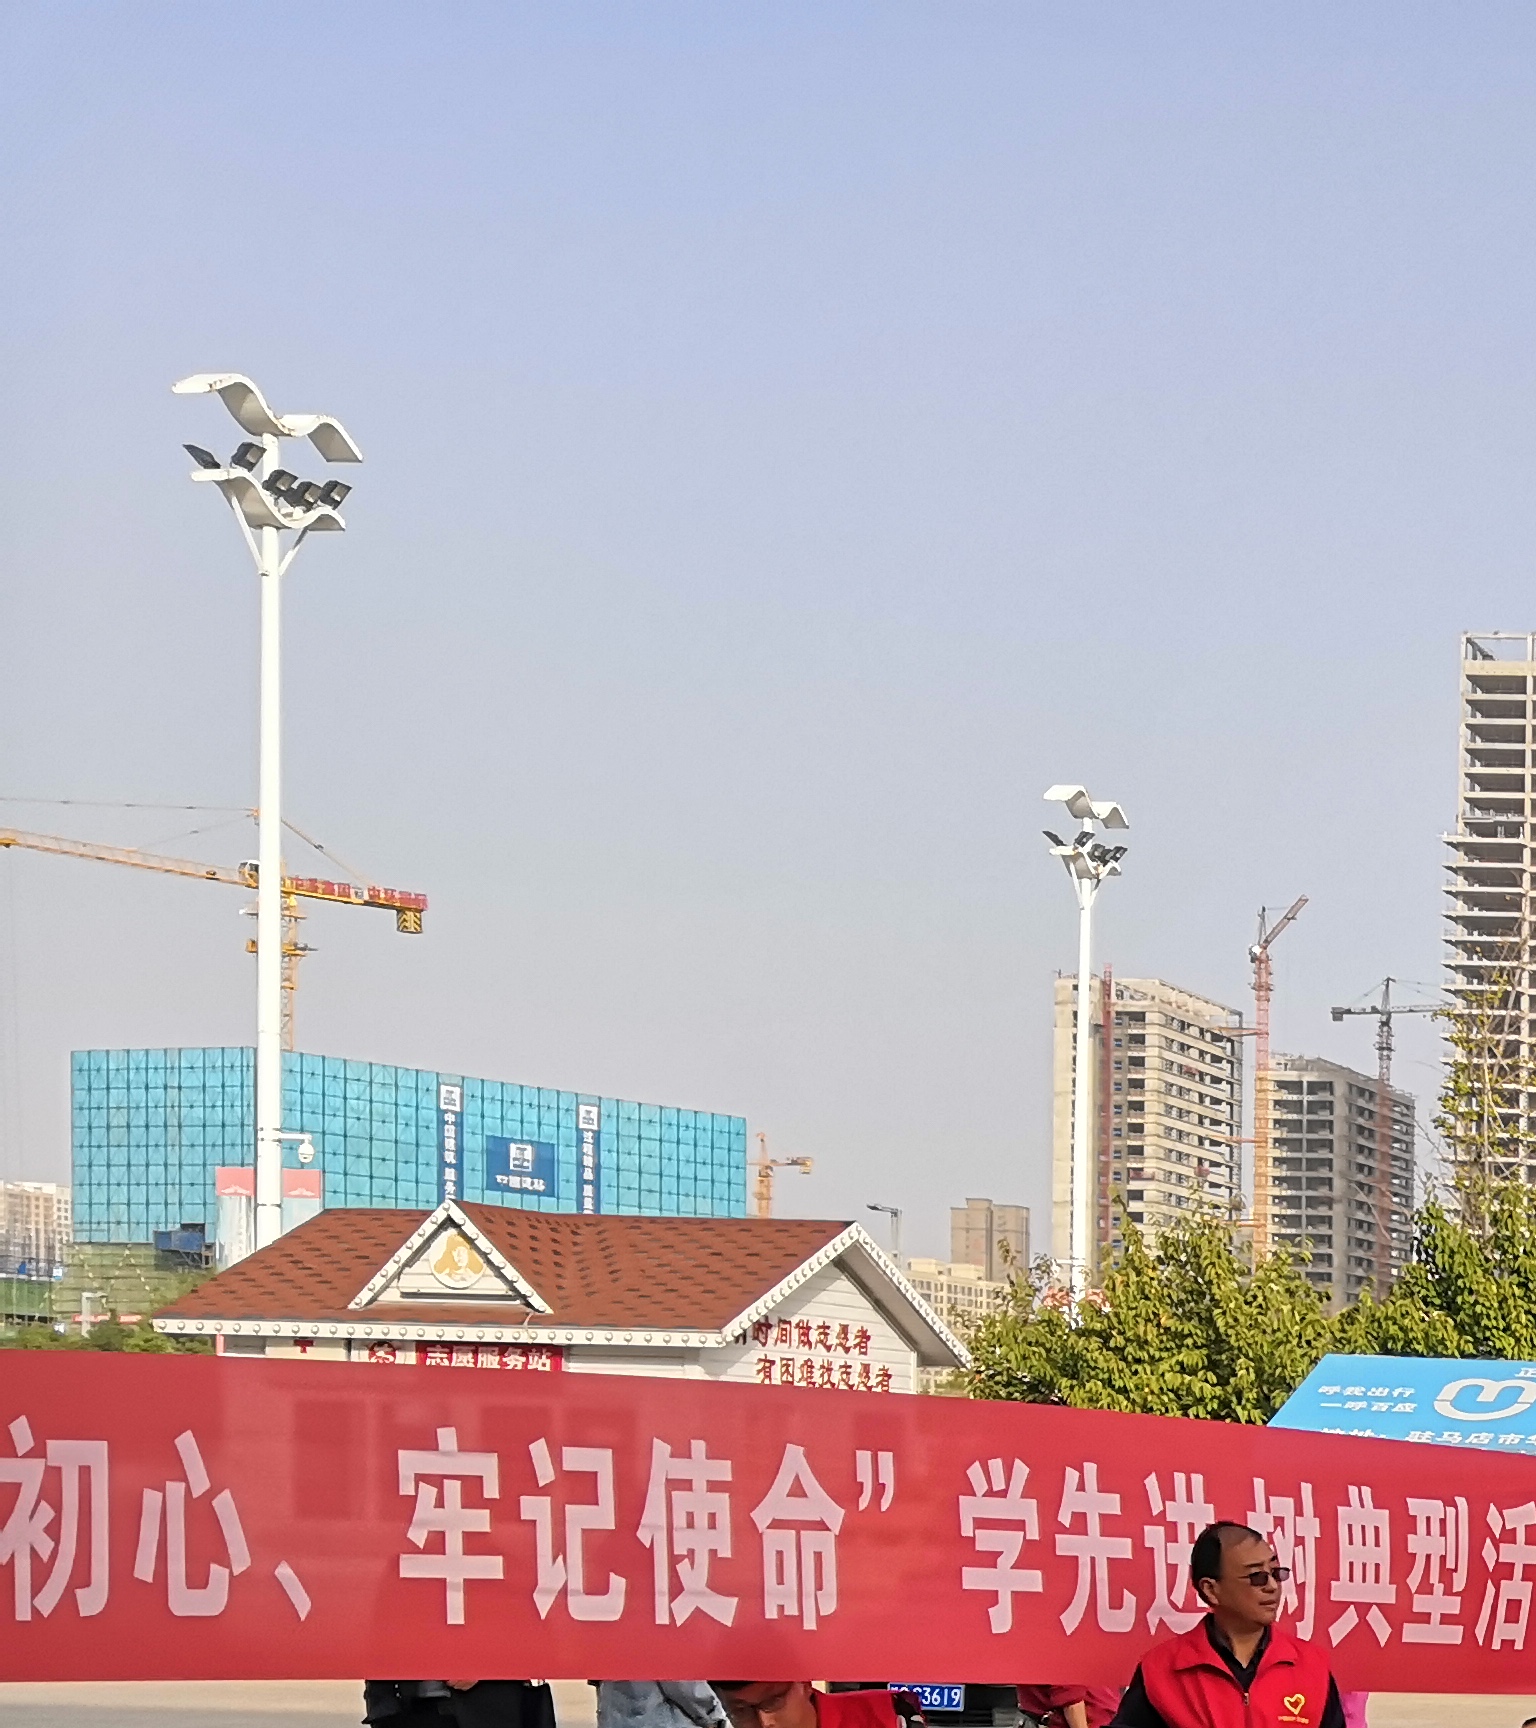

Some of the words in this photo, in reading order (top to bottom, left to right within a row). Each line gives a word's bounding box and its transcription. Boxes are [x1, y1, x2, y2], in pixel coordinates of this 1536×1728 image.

[425, 1344, 553, 1372] 志愿服务站
[756, 1354, 892, 1393] 有困难找志愿者
[1318, 1386, 1415, 1398] 呼我出行
